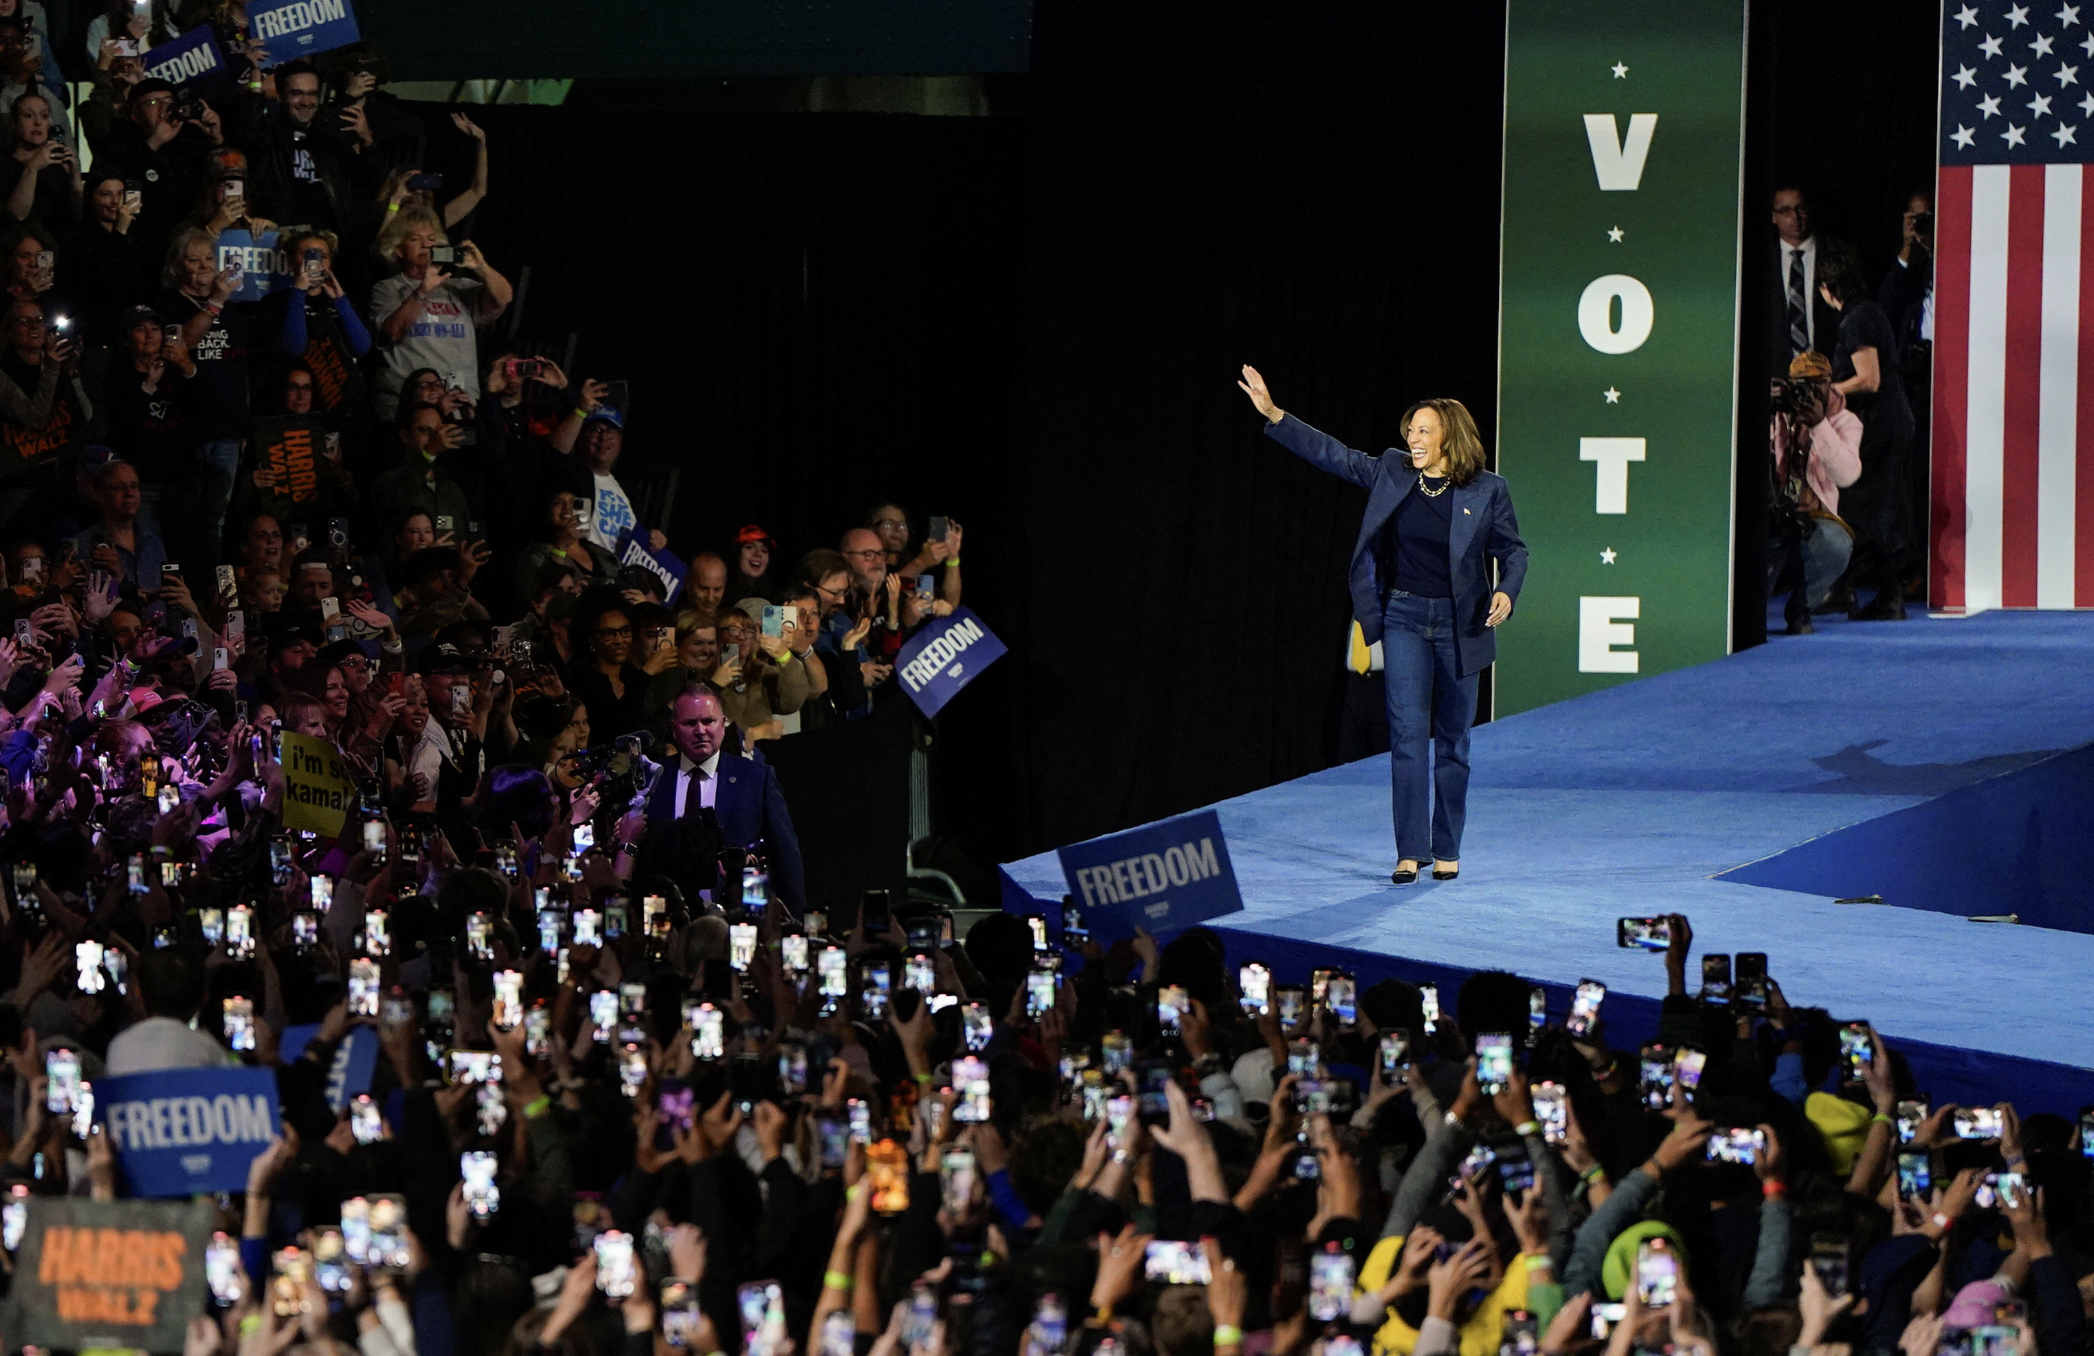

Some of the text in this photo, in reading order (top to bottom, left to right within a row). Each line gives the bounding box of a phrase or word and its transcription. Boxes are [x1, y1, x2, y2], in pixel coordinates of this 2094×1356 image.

[254, 0, 346, 39] FREEDOM
[197, 349, 223, 360] LIKE
[268, 443, 290, 496] WALZ
[283, 429, 319, 503] HARRIS
[598, 501, 632, 527] SHE
[599, 519, 620, 538] CA
[900, 617, 984, 693] FREEDOM
[293, 746, 323, 775] i'm
[1075, 837, 1221, 908] FREEDOM
[105, 1094, 273, 1151] FREEDOM
[39, 1227, 186, 1292] HARRIS
[57, 1286, 159, 1327] WALZ
